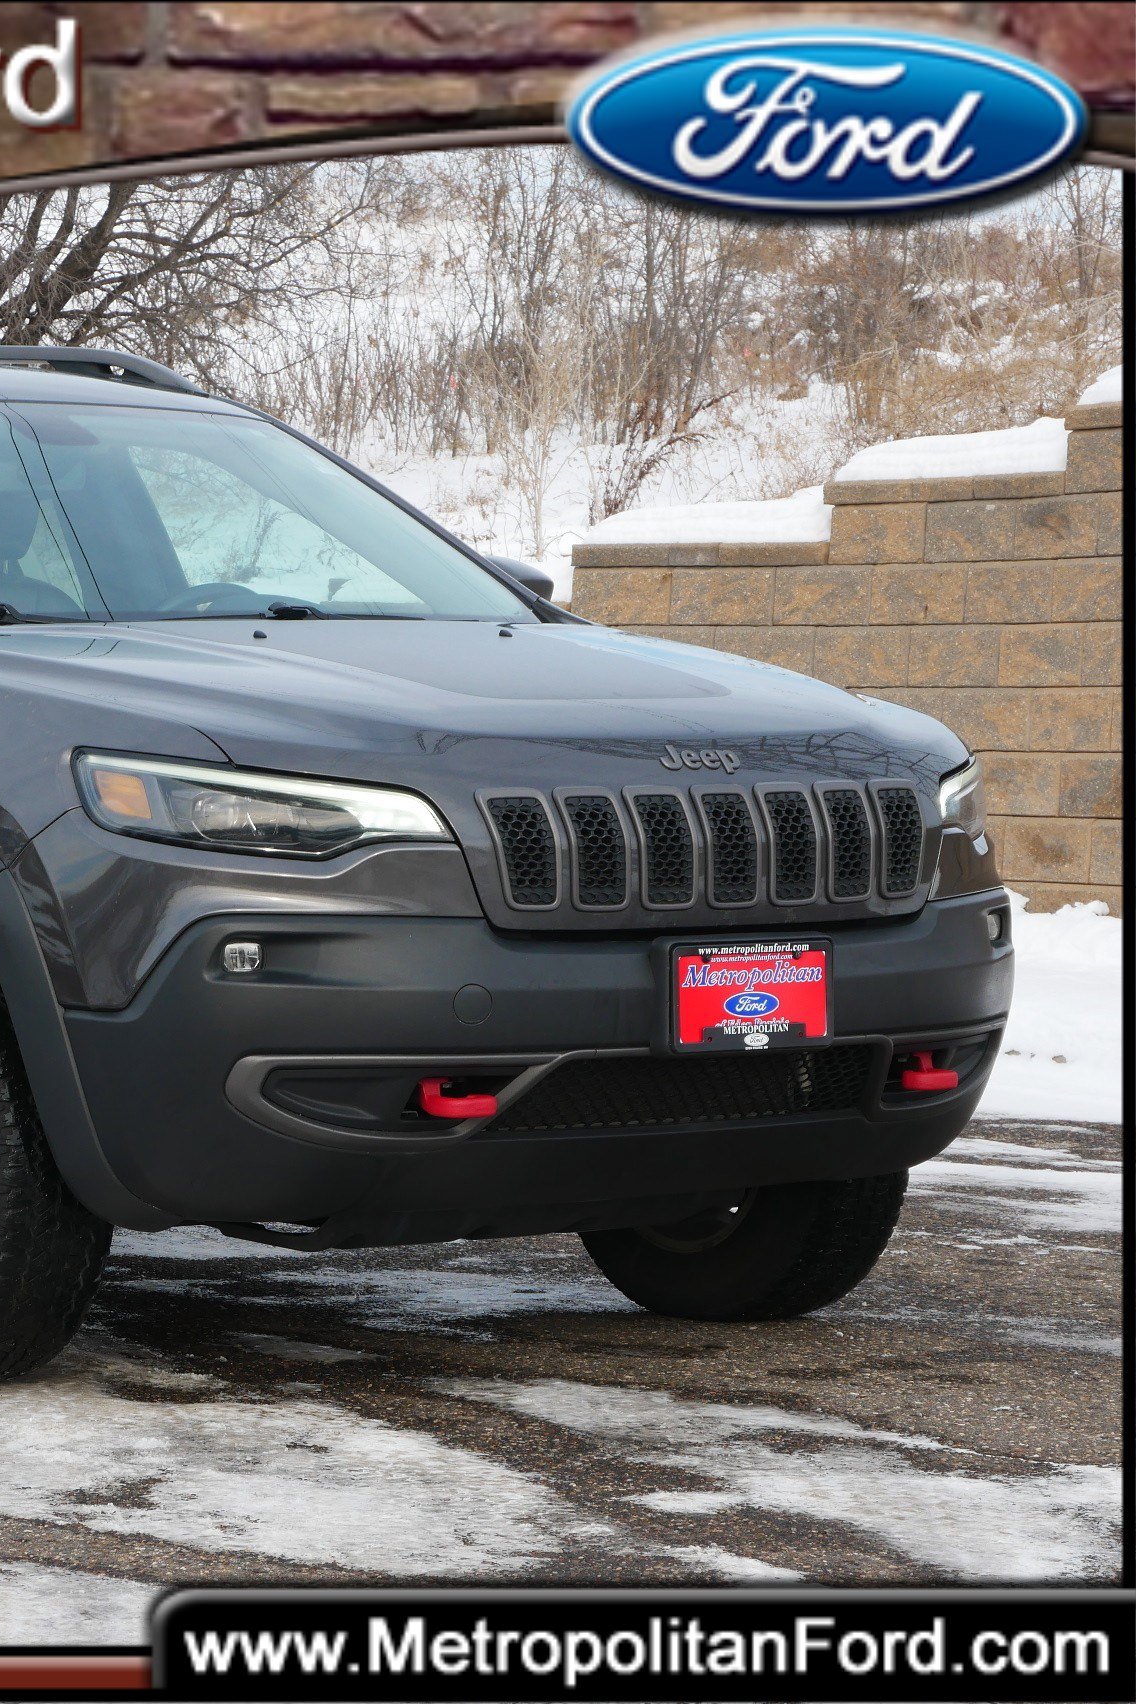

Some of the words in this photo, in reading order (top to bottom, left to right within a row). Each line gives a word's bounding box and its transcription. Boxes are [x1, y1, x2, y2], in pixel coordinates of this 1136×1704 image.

[660, 744, 741, 774] Jeep
[698, 943, 810, 956] www.metropolitanford.com
[682, 960, 823, 992] Metropolitan
[736, 996, 768, 1012] Ford
[723, 1023, 789, 1035] METROPOLITAN
